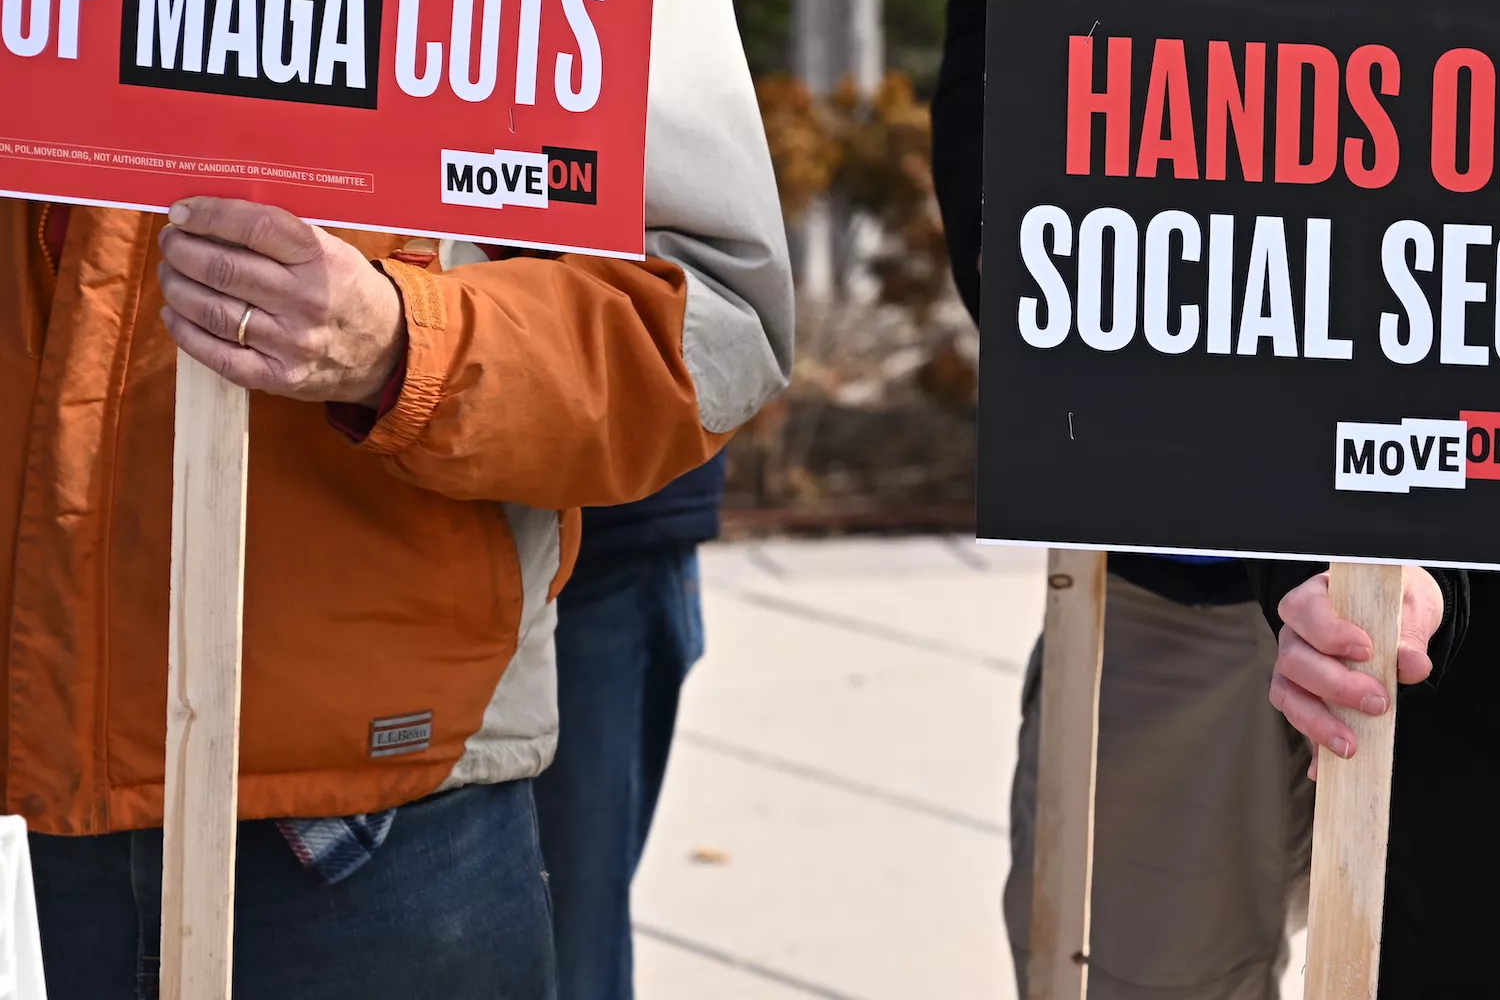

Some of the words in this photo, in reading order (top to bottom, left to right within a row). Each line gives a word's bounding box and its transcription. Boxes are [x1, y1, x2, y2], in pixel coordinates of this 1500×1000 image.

[15, 145, 91, 161] POL.MOVEON.ORG,
[93, 152, 110, 162] NOT
[112, 154, 164, 168] AUTHORIZED
[166, 160, 177, 169] BY
[178, 161, 196, 171] ANY
[197, 163, 246, 174] CANDIDATE
[247, 165, 260, 175] OR
[261, 167, 314, 181] CANDIDATE'S
[316, 173, 368, 187] COMMITTEE.
[1066, 36, 1400, 189] HANDS
[1018, 204, 1353, 360] SOCIAL
